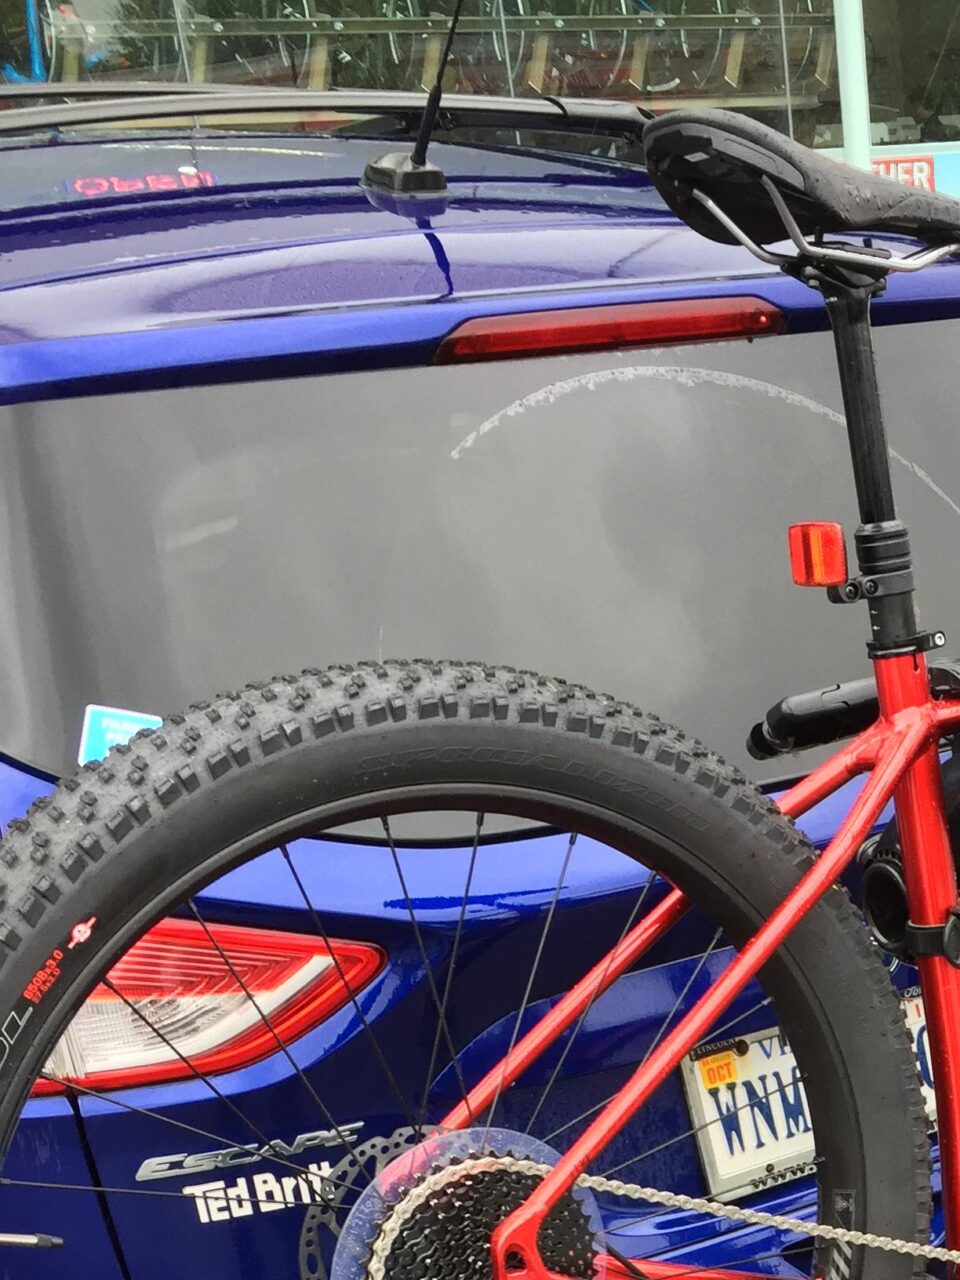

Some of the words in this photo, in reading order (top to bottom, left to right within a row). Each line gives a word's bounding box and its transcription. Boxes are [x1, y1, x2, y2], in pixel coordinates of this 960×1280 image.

[696, 1038, 737, 1055] LINCOLN
[706, 1062, 733, 1085] OCT
[135, 1121, 365, 1182] ESCAPE
[182, 1177, 253, 1223] Ted
